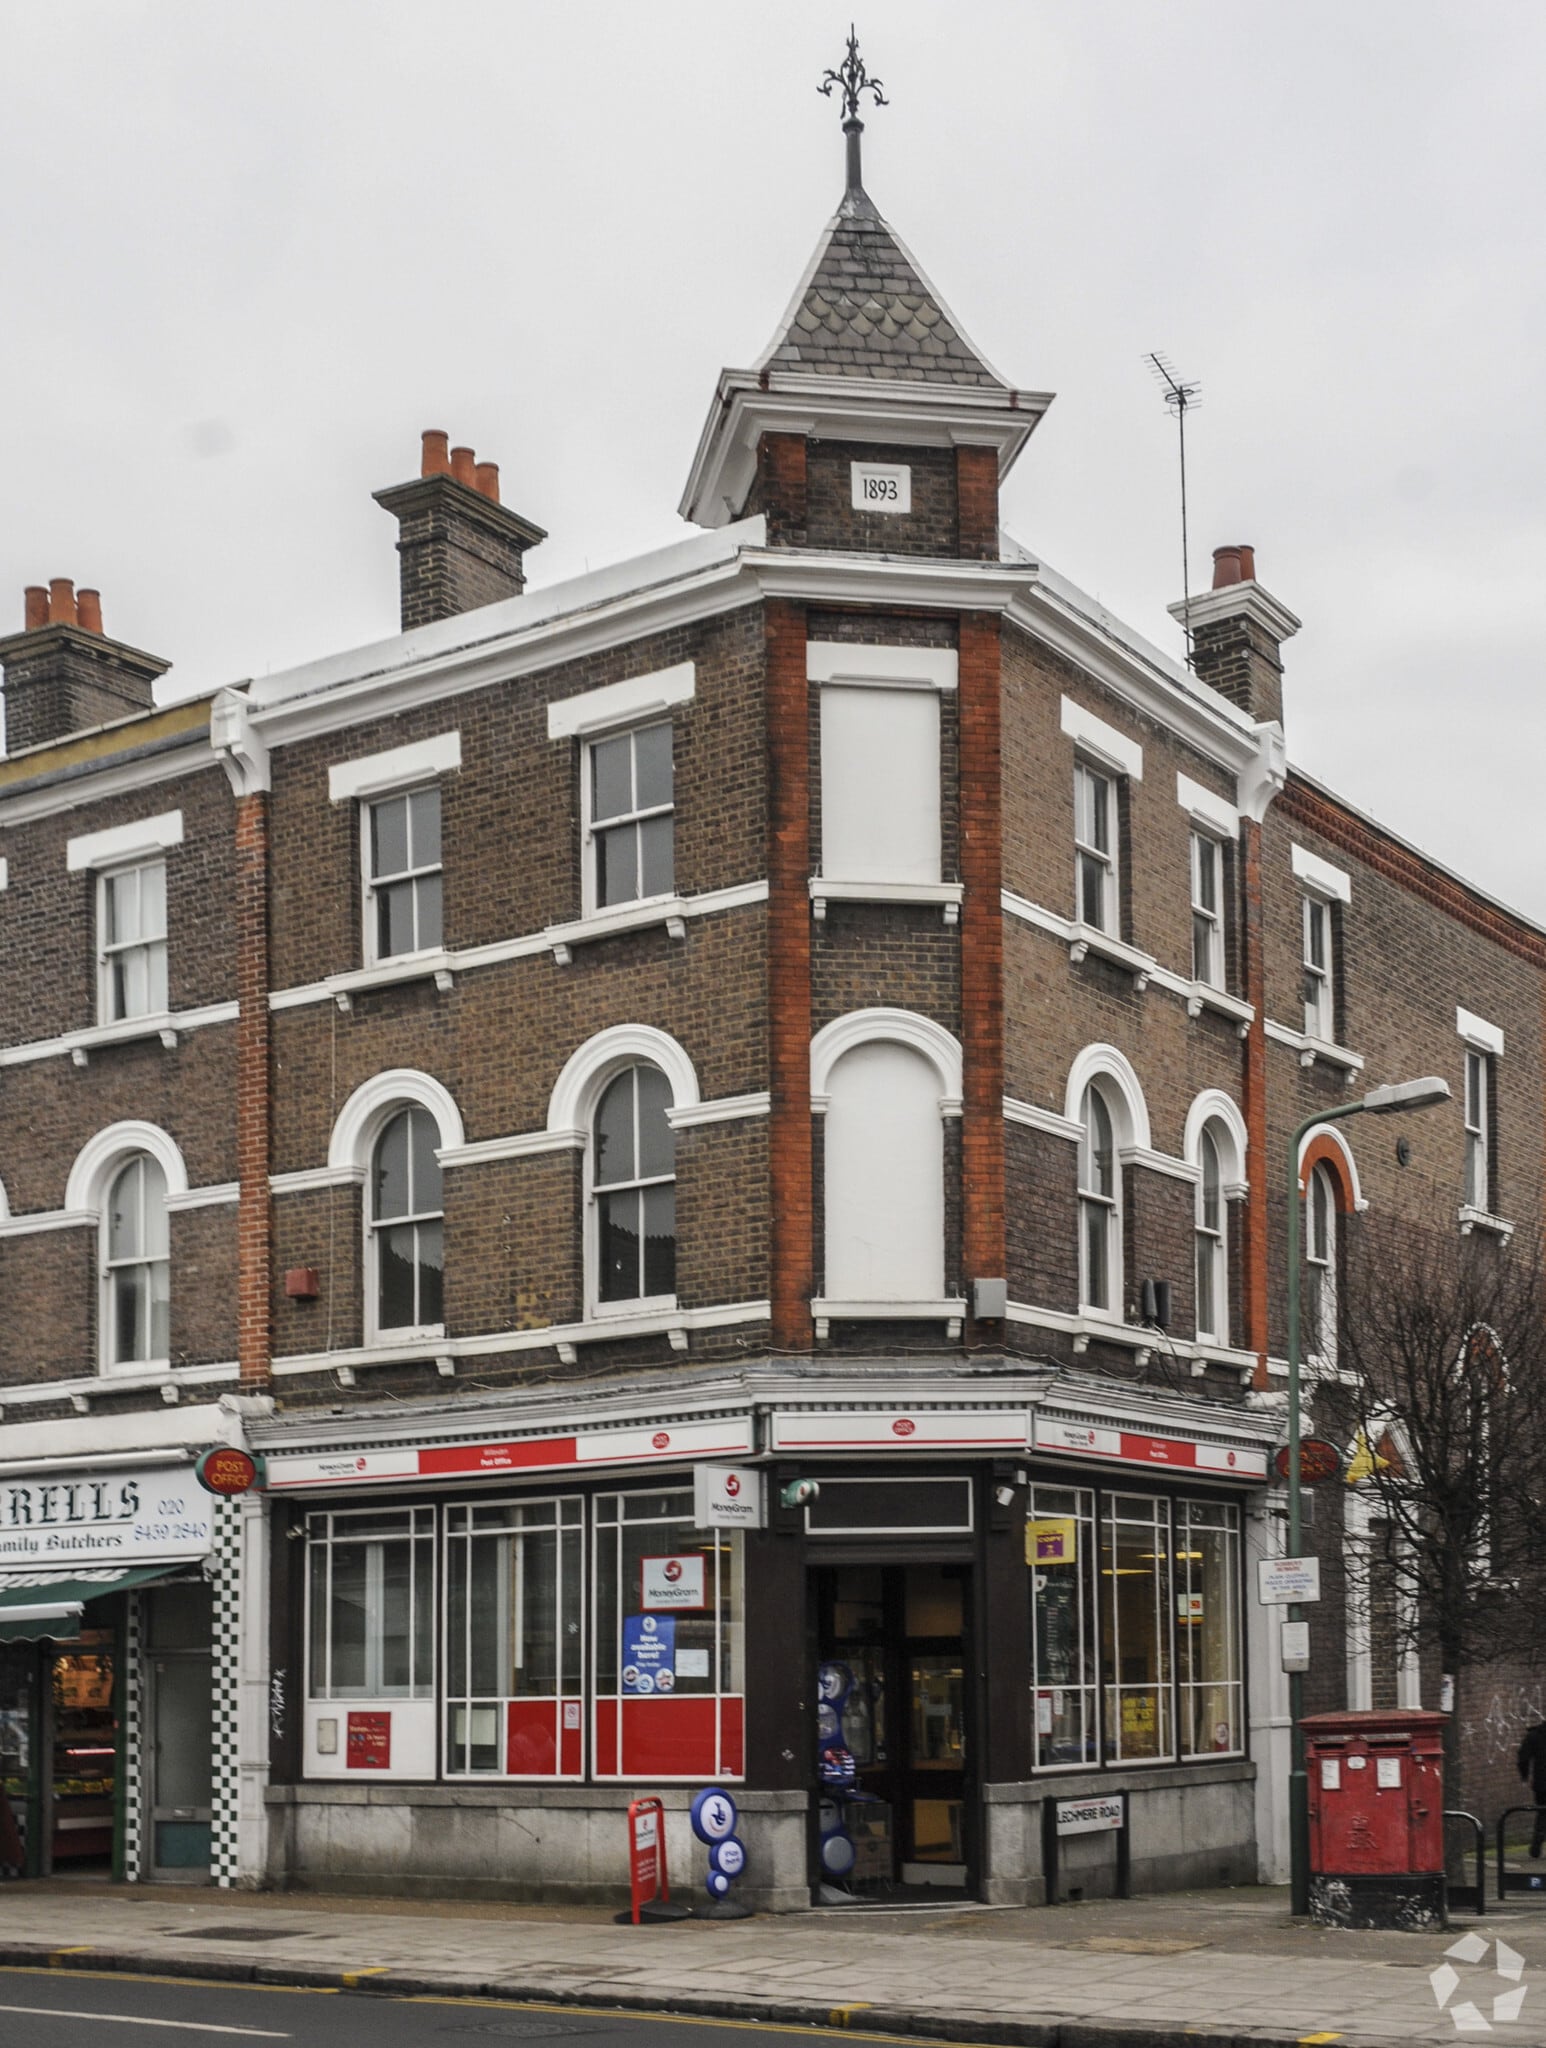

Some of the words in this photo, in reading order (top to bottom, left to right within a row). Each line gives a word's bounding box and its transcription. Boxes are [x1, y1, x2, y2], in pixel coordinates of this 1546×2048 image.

[863, 478, 898, 501] 1893
[215, 1460, 244, 1473] POST
[211, 1473, 249, 1487] OFFICE
[0, 1481, 140, 1525] RELLS
[157, 1498, 186, 1516] 020
[712, 1502, 754, 1514] MoneyGram
[45, 1533, 124, 1552] Butchers
[648, 1587, 699, 1598] MoneyGram
[1056, 1808, 1098, 1824] LECHMERE
[1099, 1804, 1120, 1818] ROAD
